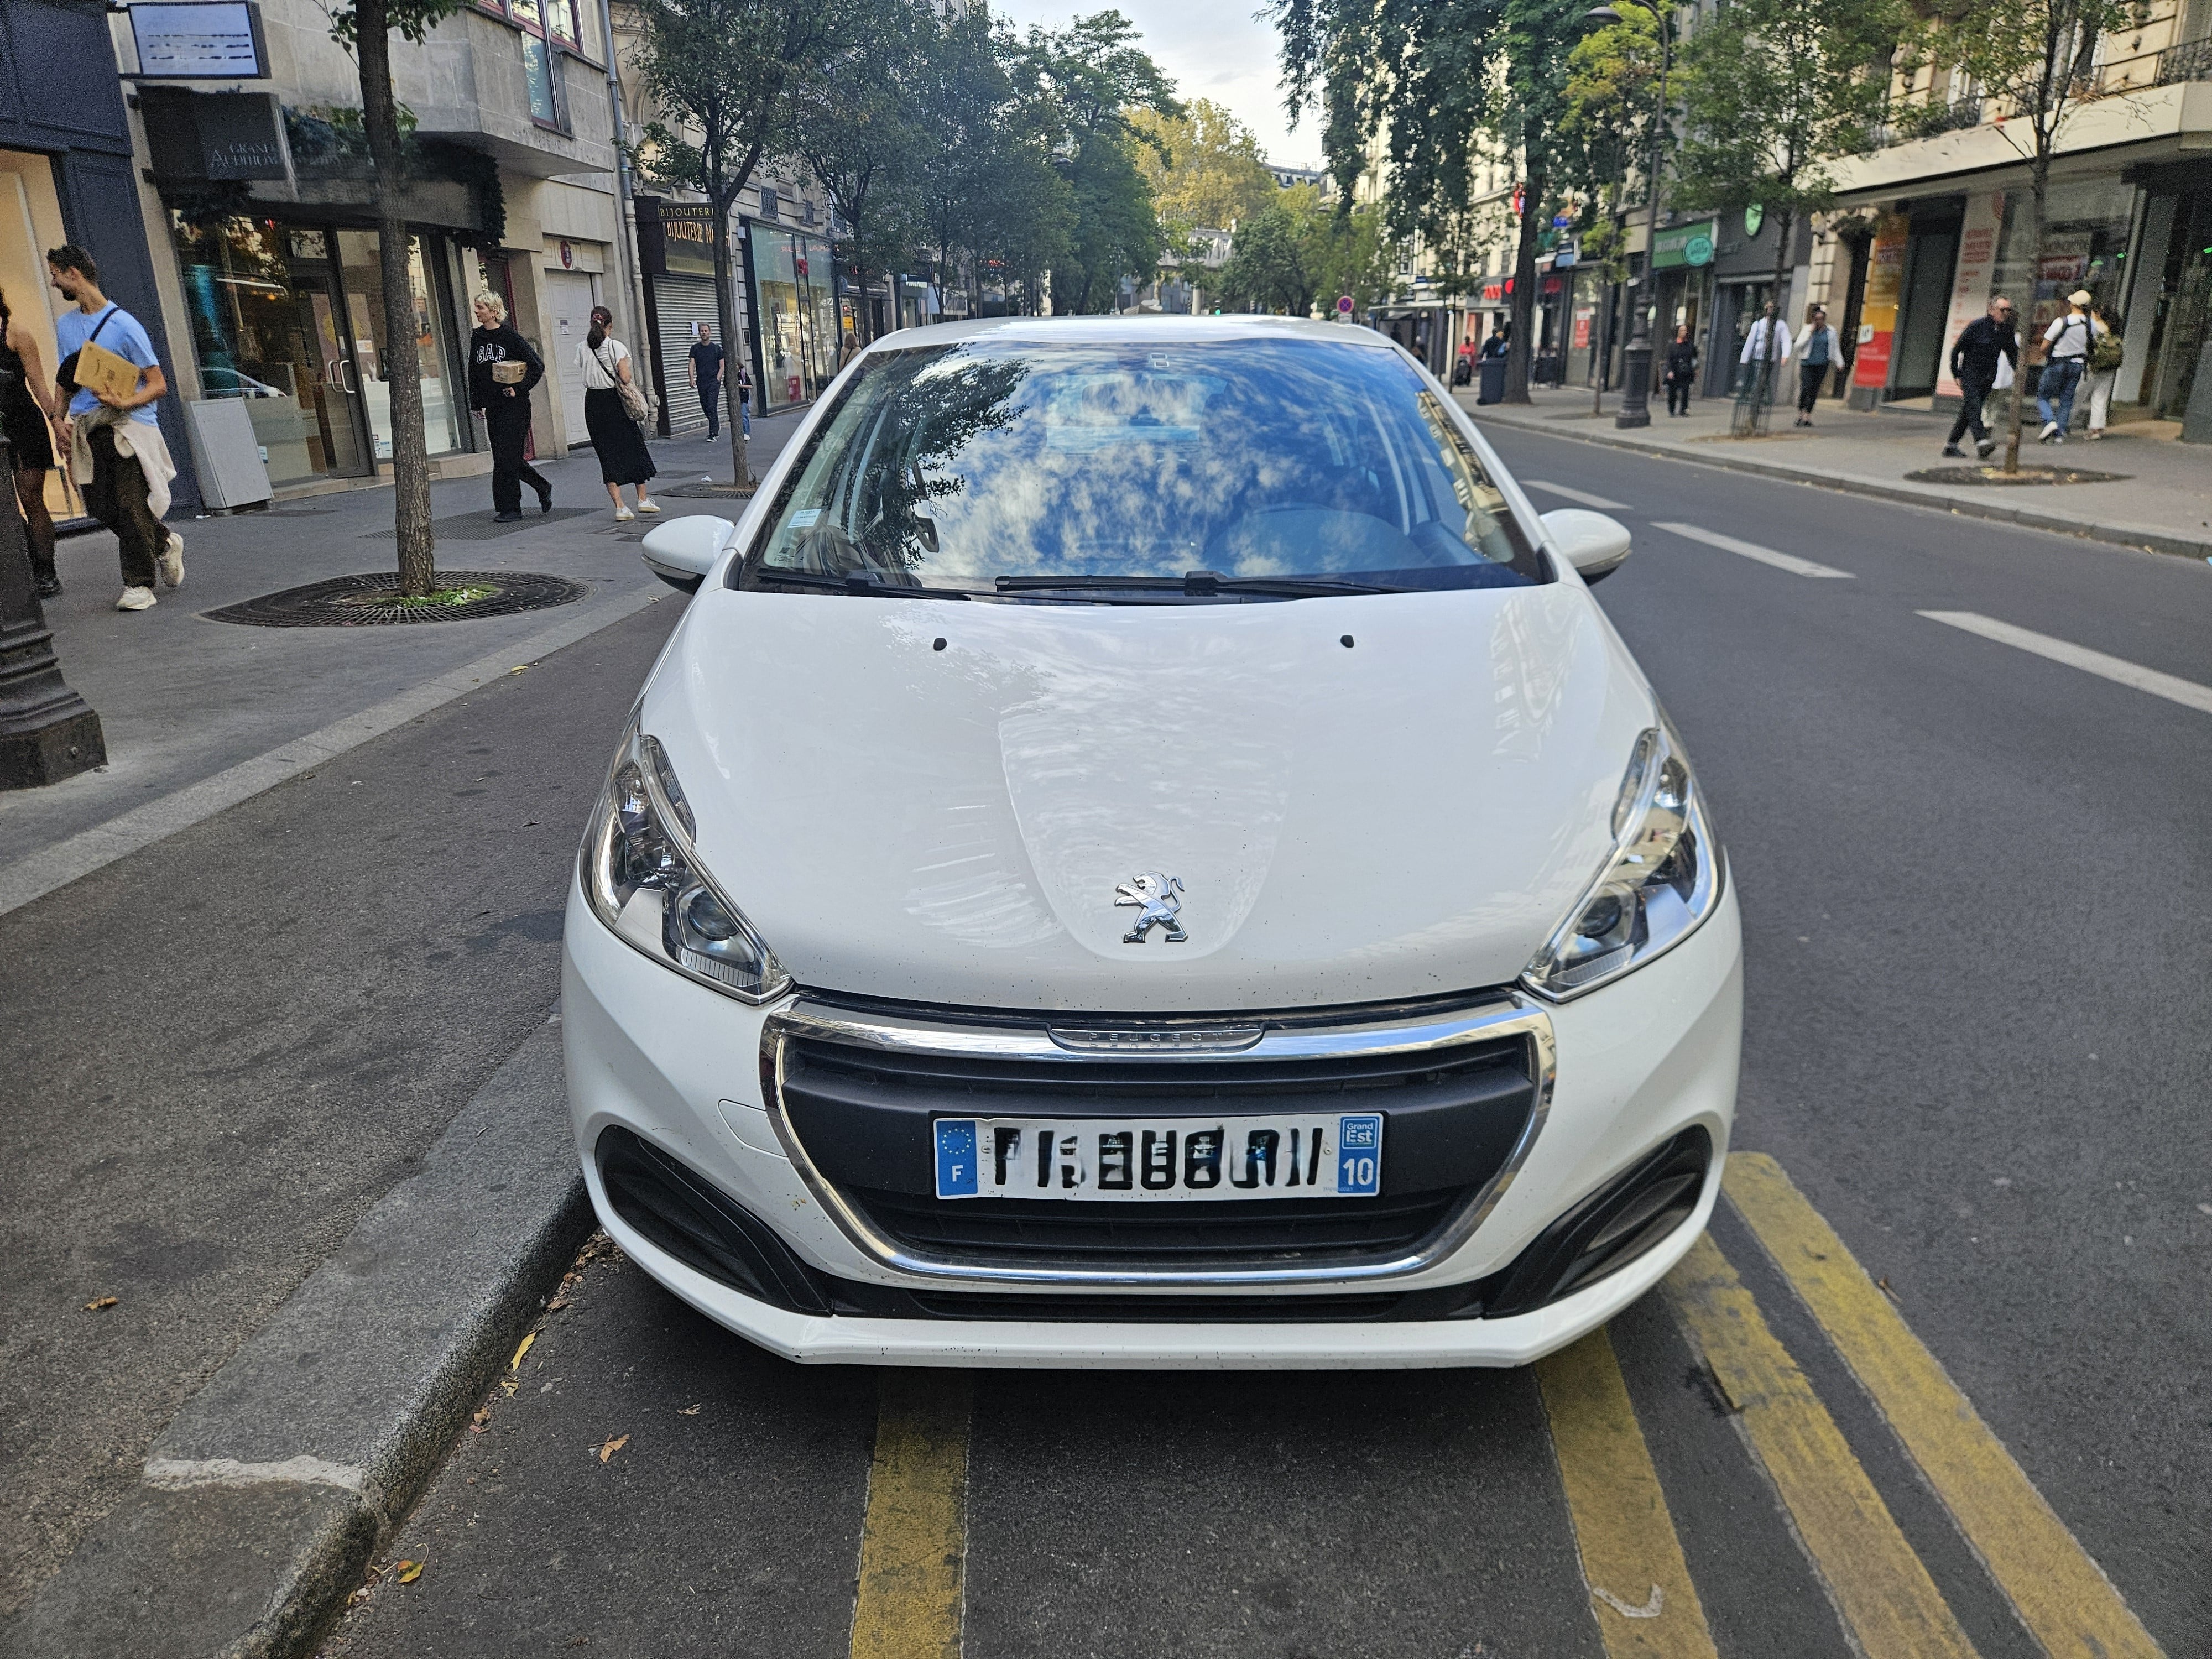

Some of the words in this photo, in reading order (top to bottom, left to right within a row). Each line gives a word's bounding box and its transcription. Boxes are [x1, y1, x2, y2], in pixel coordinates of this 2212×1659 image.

[660, 207, 713, 217] BIJOUTERI
[666, 221, 703, 242] BIJOUTERIE
[477, 343, 505, 364] GAP
[1088, 1032, 1223, 1041] PEUGEOT
[1346, 1130, 1373, 1142] Est
[952, 1165, 963, 1182] F
[1343, 1157, 1374, 1186] 10
